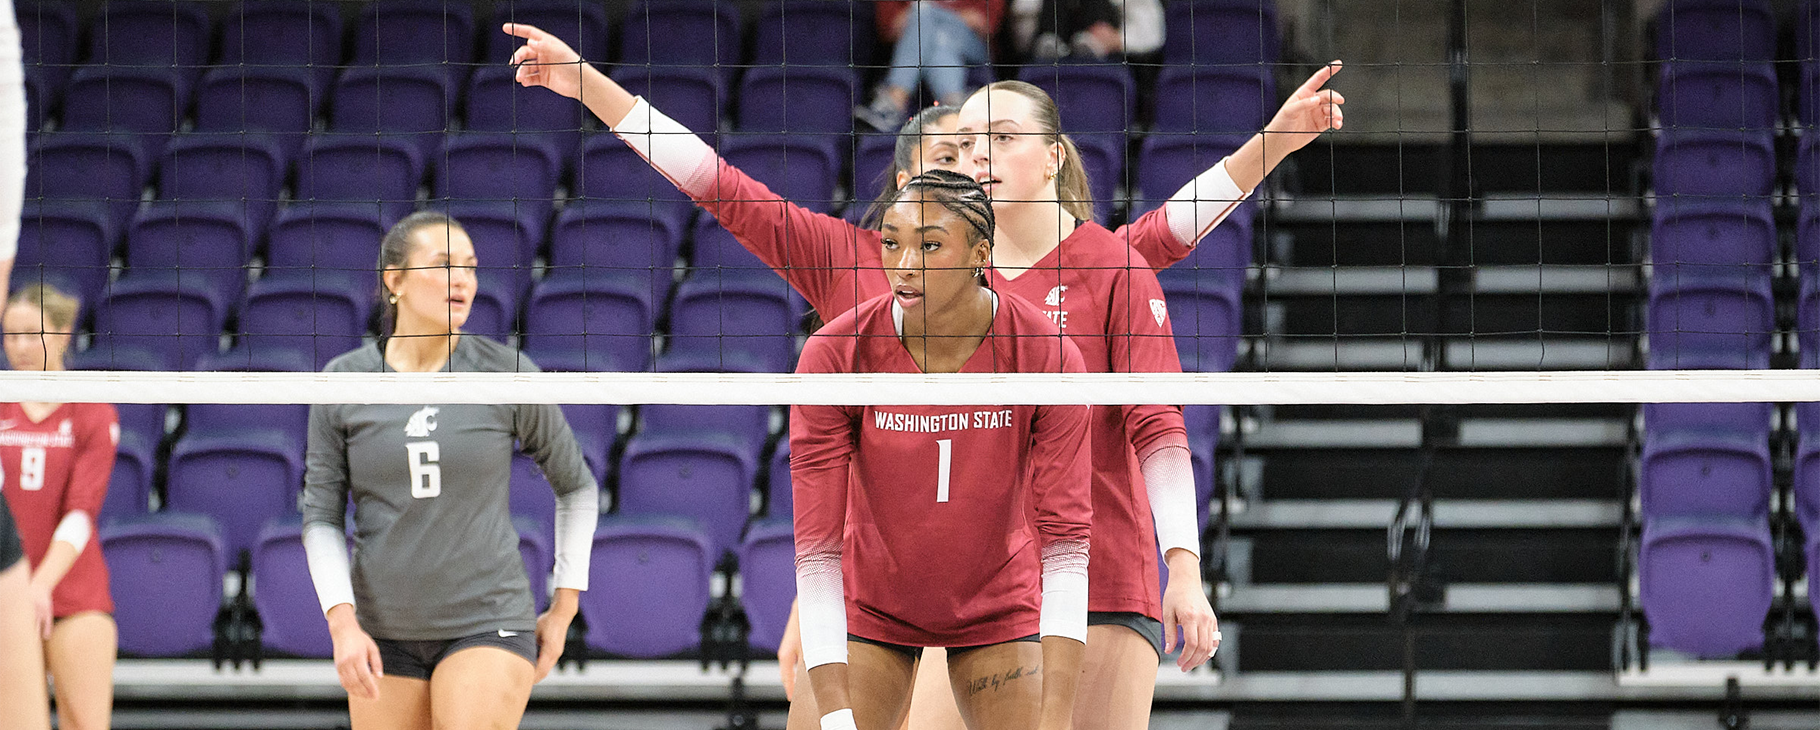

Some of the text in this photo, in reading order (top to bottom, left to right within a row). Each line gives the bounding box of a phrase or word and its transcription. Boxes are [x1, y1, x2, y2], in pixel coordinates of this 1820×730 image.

[874, 410, 1012, 433] WASHINGTON STATE
[20, 446, 46, 491] 9
[405, 441, 441, 499] 6
[936, 439, 952, 503] 1
